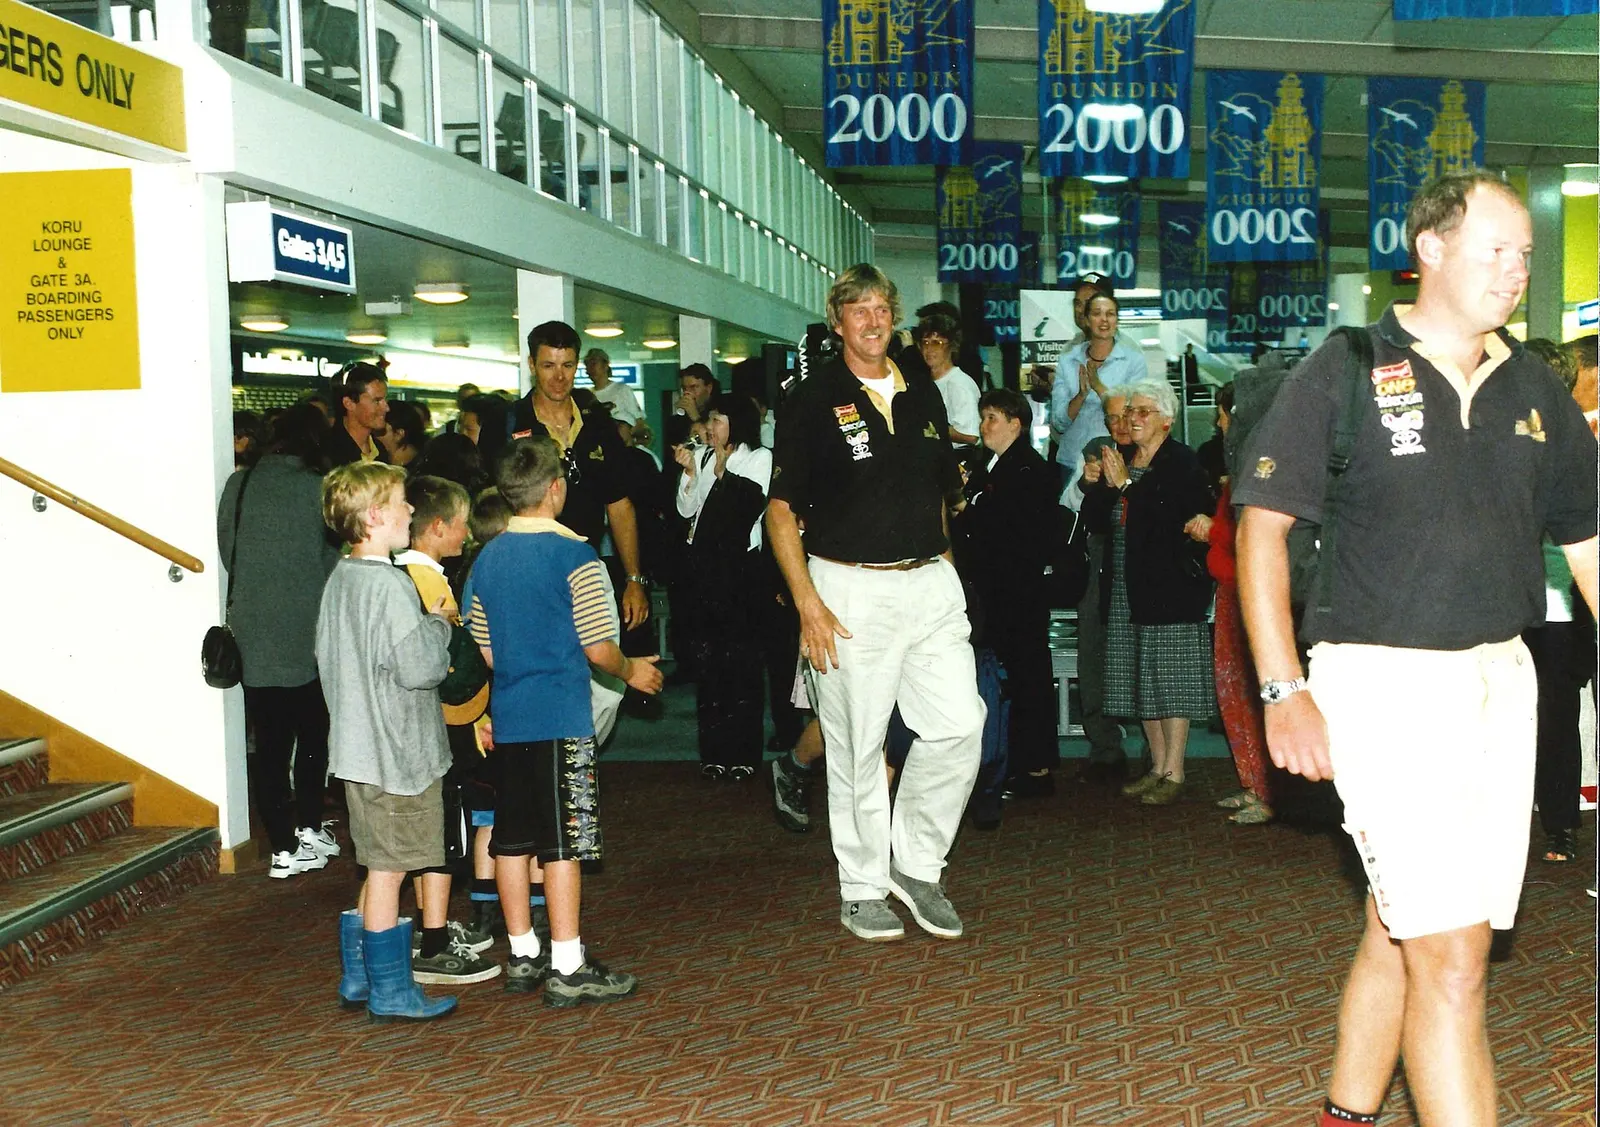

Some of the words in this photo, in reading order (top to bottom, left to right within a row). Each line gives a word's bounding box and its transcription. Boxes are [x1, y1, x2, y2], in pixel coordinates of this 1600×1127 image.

[76, 53, 135, 110] ONLY
[836, 71, 960, 89] DUNEDIN
[1051, 81, 1178, 98] DUNEDIN
[827, 92, 967, 143] 2000
[1043, 103, 1185, 154] 2000
[41, 220, 82, 233] KORU
[32, 237, 92, 252] LOUNGE
[57, 256, 67, 269] &
[939, 243, 1019, 271] 2000
[1057, 250, 1134, 279] 2000
[30, 273, 68, 287] GATE
[26, 290, 102, 305] BOARDING
[17, 307, 114, 323] PASSENGERS
[47, 327, 84, 340] ONLY
